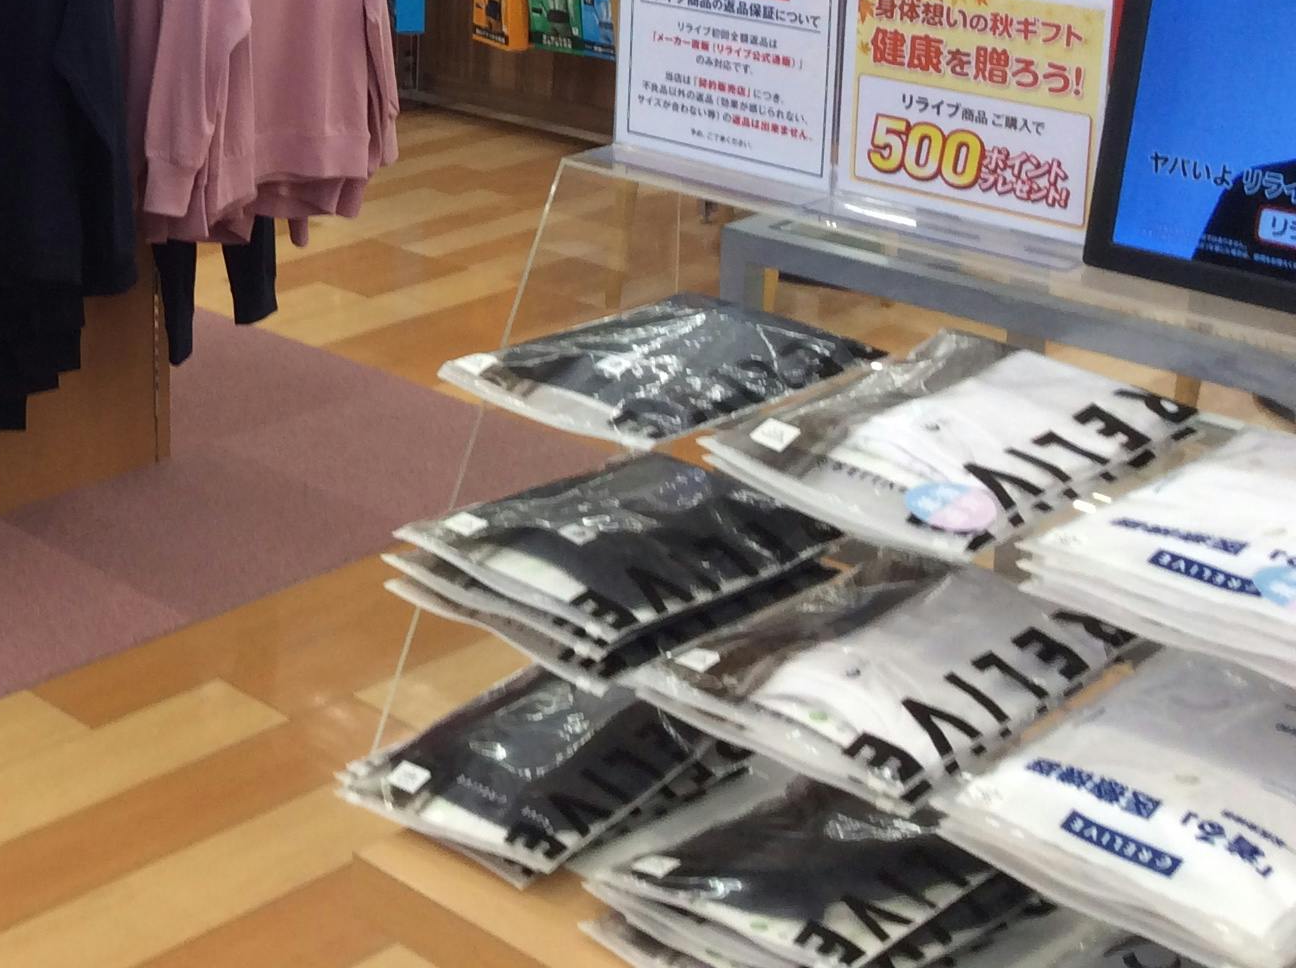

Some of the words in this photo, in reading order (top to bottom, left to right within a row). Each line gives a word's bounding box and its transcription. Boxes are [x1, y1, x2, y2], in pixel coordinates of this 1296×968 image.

[1150, 151, 1233, 190] ヤバいよ
[1069, 815, 1152, 864] RELIVE
